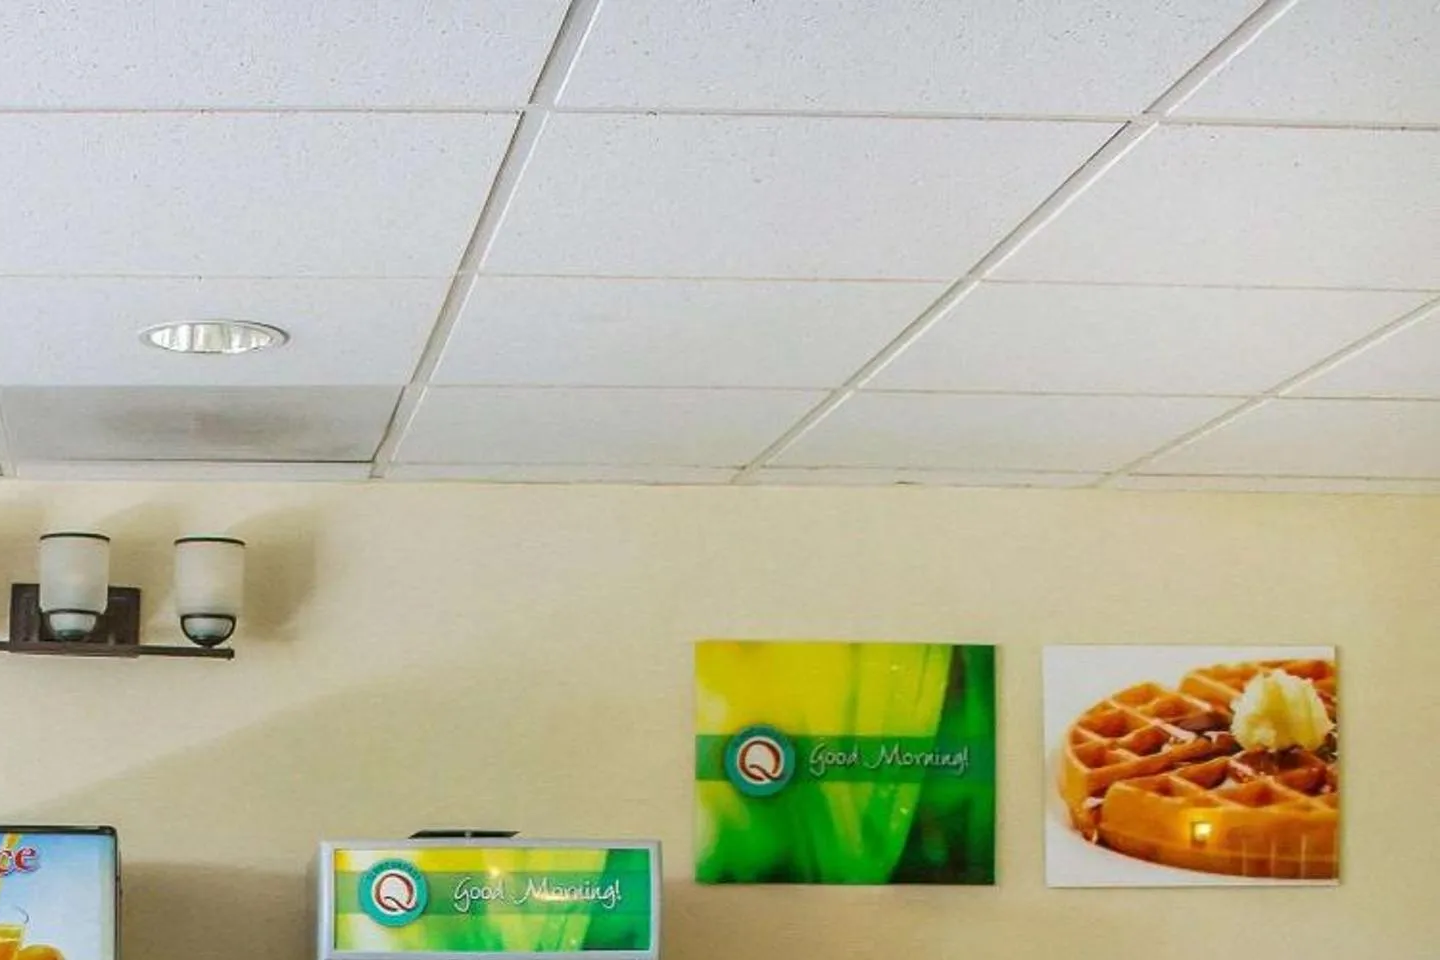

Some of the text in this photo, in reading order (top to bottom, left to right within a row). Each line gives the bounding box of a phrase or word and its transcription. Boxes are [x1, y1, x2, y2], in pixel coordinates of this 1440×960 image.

[810, 742, 969, 776] Good Morning!
[454, 876, 621, 912] Good Morning!
